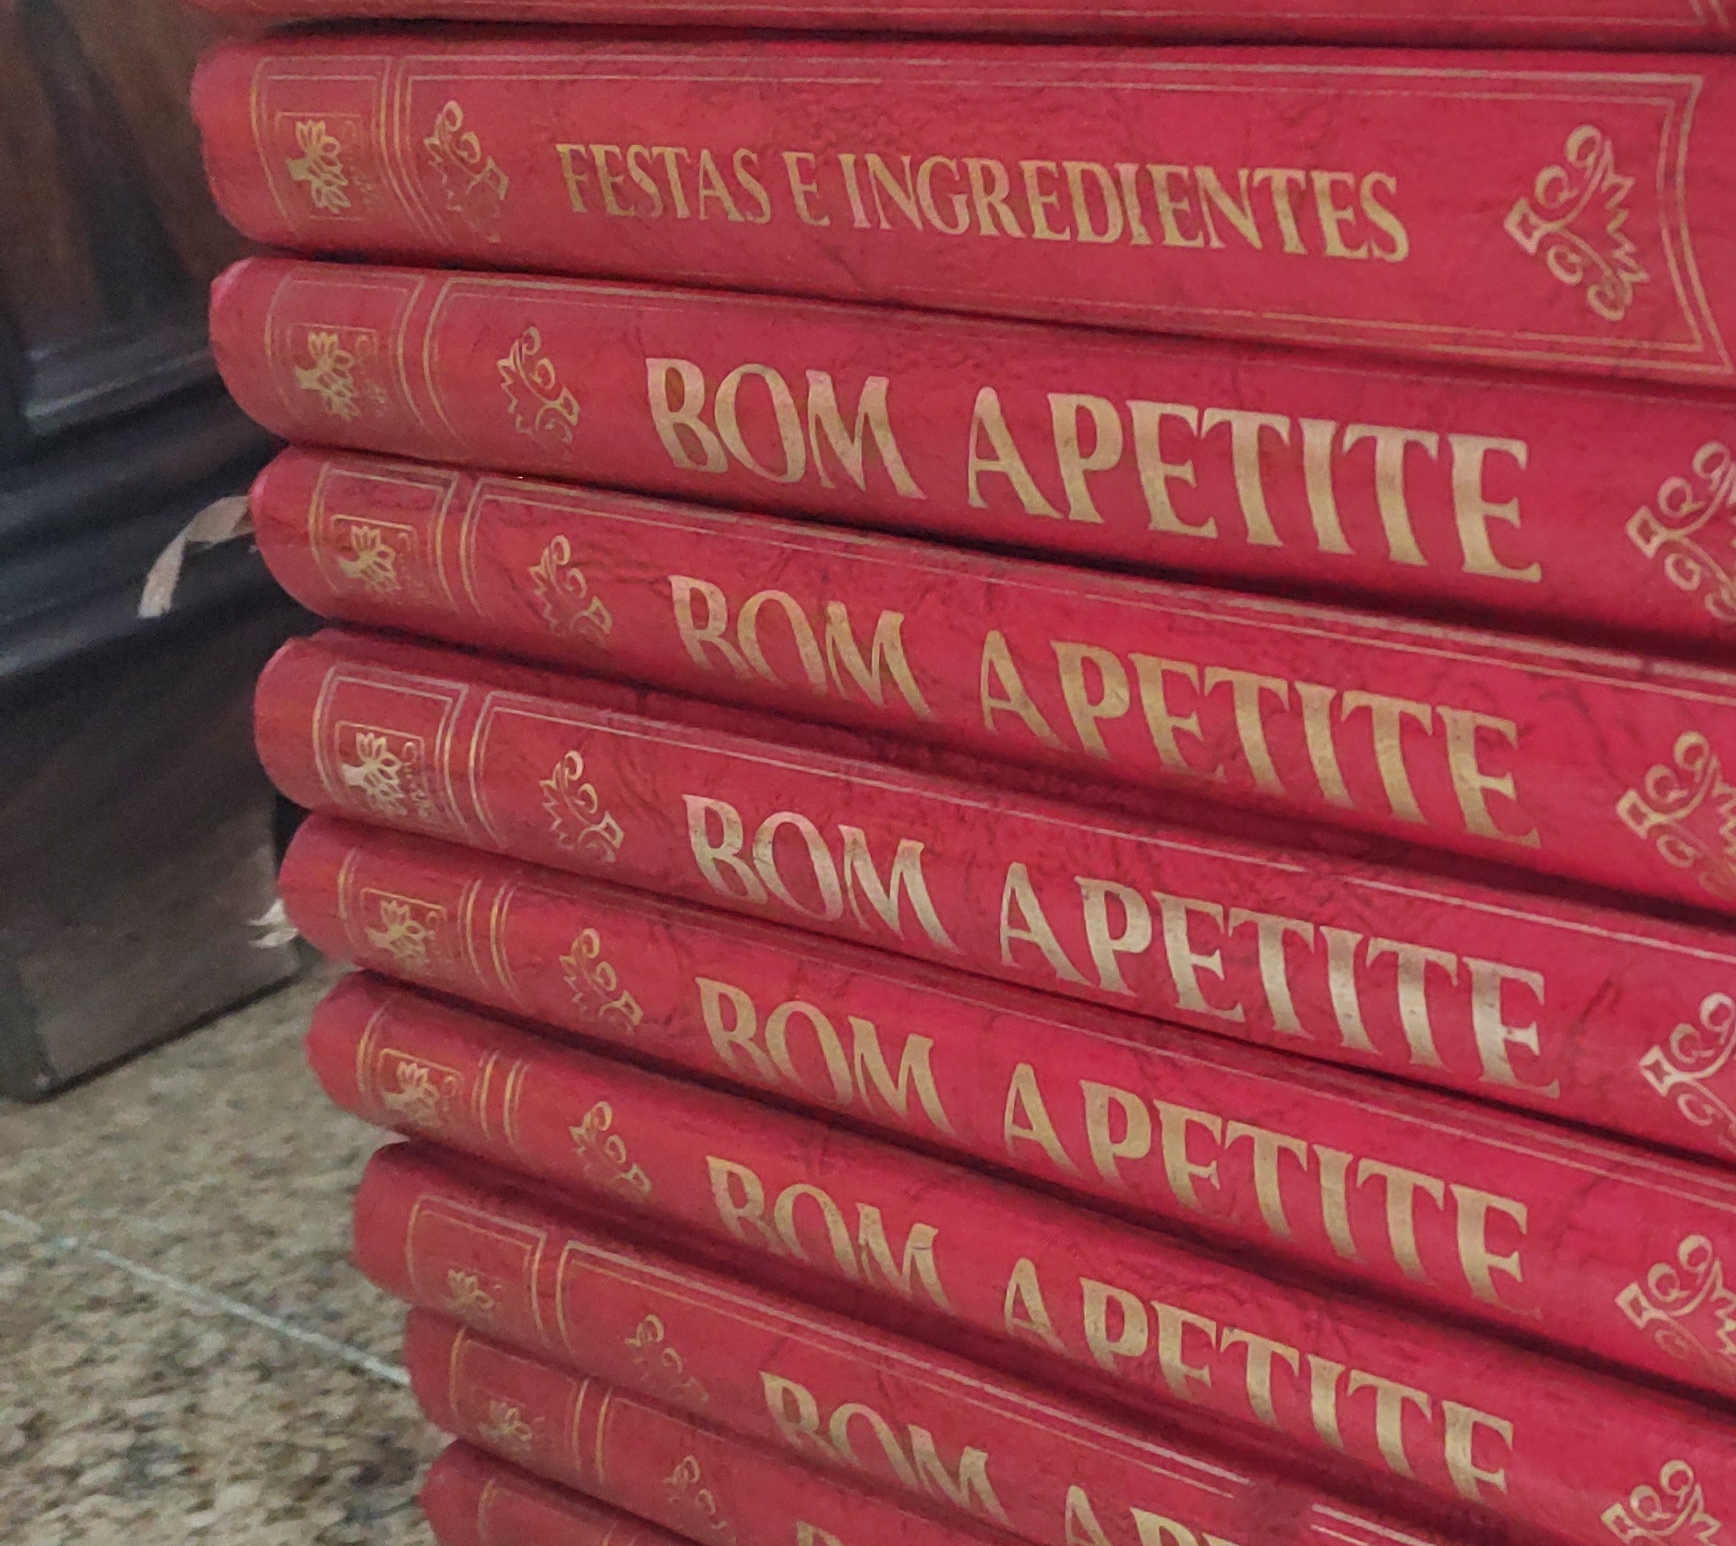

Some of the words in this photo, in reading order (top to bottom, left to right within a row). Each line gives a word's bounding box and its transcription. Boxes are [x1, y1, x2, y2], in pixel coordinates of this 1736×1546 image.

[555, 142, 772, 227] FESTAS
[790, 150, 831, 227] E
[840, 151, 1411, 262] INGREDIENTES
[645, 356, 929, 500] BOM
[966, 385, 1543, 584] APETITE
[668, 574, 934, 723] BOM
[979, 628, 1542, 850] APETITE
[681, 792, 962, 954] BOM
[998, 860, 1561, 1100] APETITE
[694, 975, 964, 1139] BOM
[1003, 1061, 1544, 1321] APETITE
[705, 1154, 958, 1319] BOM
[1003, 1256, 1515, 1505] APETITE
[758, 1370, 1016, 1530] BOM
